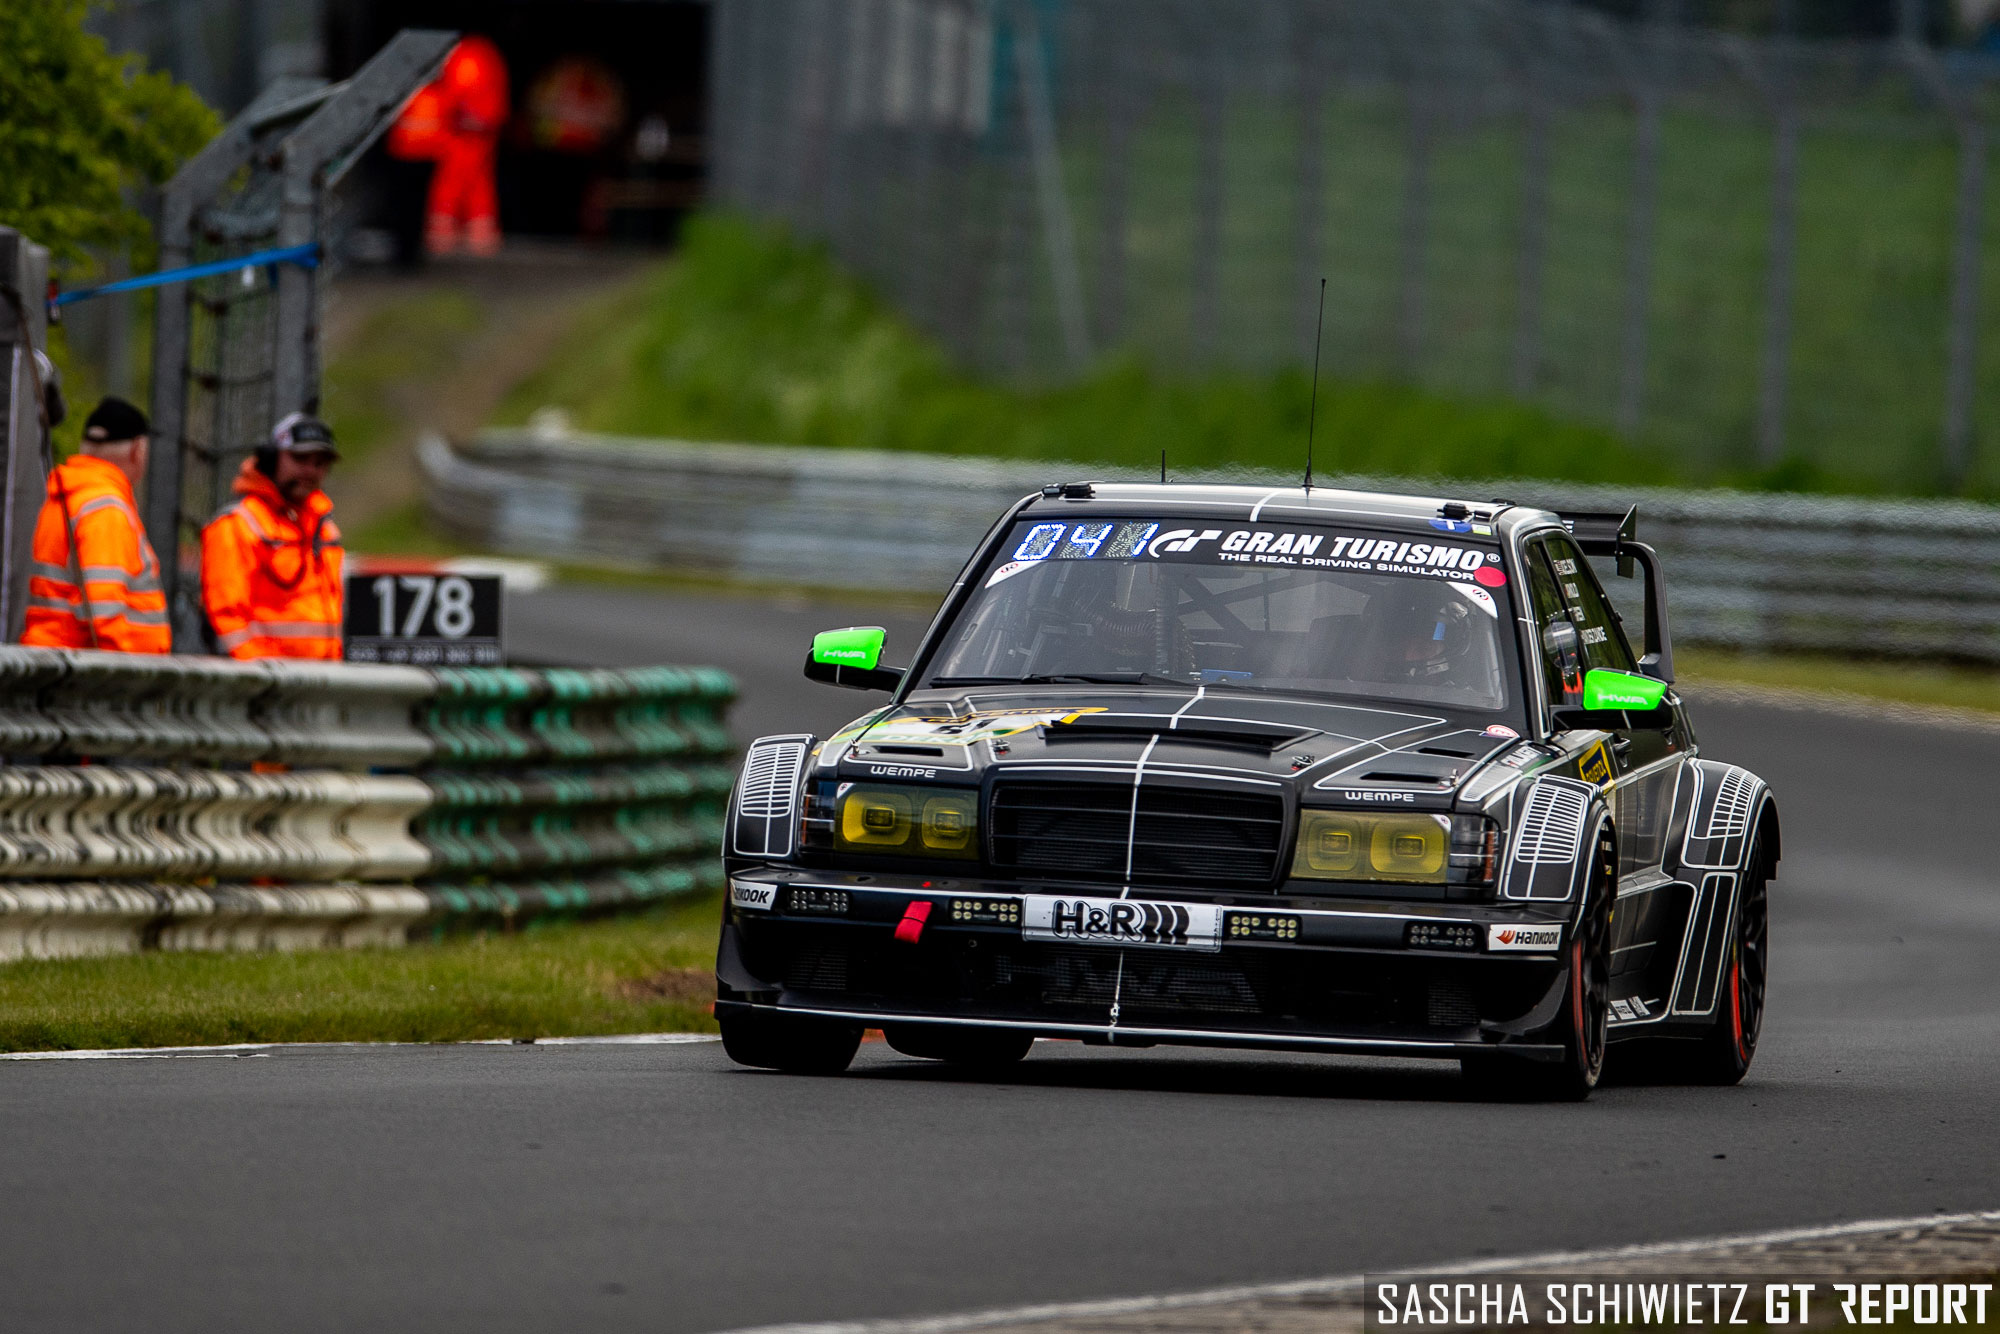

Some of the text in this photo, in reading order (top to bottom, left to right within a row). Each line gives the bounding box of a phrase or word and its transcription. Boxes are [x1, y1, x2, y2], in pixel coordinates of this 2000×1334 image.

[1013, 523, 1160, 560] 041
[1221, 530, 1324, 556] GRAN
[1218, 552, 1475, 581] THE REAL DRIVING SIMULATOR
[372, 575, 475, 640] 178
[1597, 693, 1649, 705] HWA
[870, 764, 937, 778] WEMPE
[1344, 790, 1415, 803] WEMPE
[1053, 899, 1144, 942] H&R
